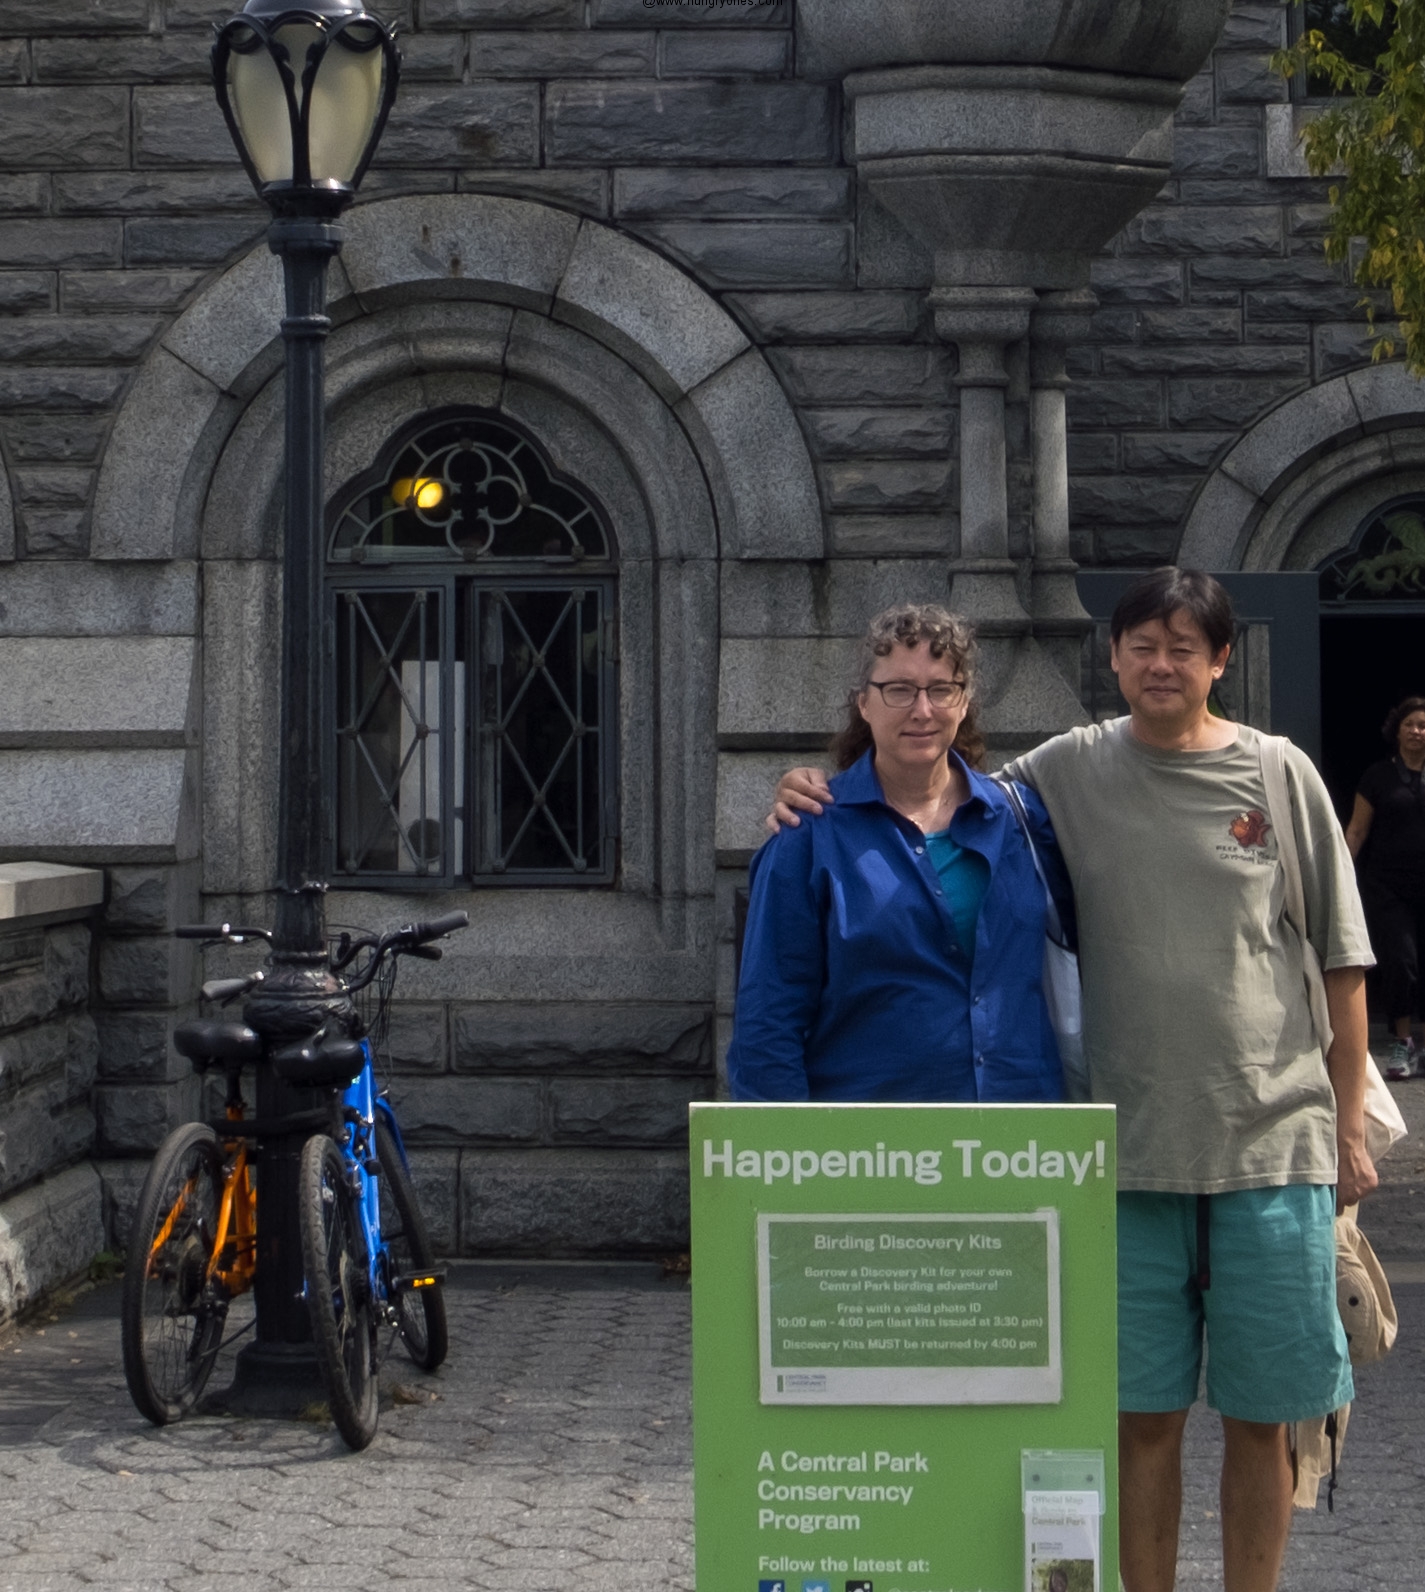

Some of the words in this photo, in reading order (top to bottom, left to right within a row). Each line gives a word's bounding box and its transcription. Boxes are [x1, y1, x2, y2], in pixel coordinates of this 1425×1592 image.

[703, 1140, 942, 1185] Happening
[953, 1140, 1106, 1185] Today!
[814, 1234, 875, 1252] Birding
[879, 1234, 963, 1251] Discovery
[969, 1234, 1002, 1250] Kits
[805, 1267, 848, 1277] Borrow
[850, 1269, 858, 1277] a
[861, 1267, 917, 1278] Discovery
[921, 1267, 936, 1277] Kit
[939, 1267, 956, 1277] for
[960, 1269, 984, 1278] your
[988, 1268, 1013, 1277] own
[819, 1281, 861, 1291] Central
[864, 1281, 890, 1291] Park
[894, 1281, 934, 1292] birding
[936, 1280, 998, 1291] adventure!
[837, 1303, 863, 1313] Free
[866, 1303, 891, 1313] with
[894, 1305, 901, 1313] a
[904, 1303, 931, 1313] valid
[933, 1302, 966, 1315] photo
[969, 1302, 981, 1313] ID
[777, 1317, 807, 1327] 10:00
[809, 1319, 827, 1327] am
[838, 1317, 864, 1327] 4:00
[866, 1319, 884, 1328] pm
[886, 1317, 912, 1327] (last
[915, 1316, 936, 1327] kits
[939, 1316, 976, 1327] issued
[979, 1317, 991, 1326] at
[993, 1316, 1019, 1327] 3:30
[1021, 1317, 1043, 1327] pm)
[783, 1339, 840, 1351] Discovery
[843, 1339, 865, 1349] Kits
[868, 1339, 901, 1349] MUST
[904, 1339, 918, 1349] be
[921, 1338, 971, 1349] returned
[974, 1338, 988, 1350] by
[991, 1338, 1017, 1348] 4:00
[1019, 1340, 1037, 1350] pm
[757, 1451, 775, 1472] A
[781, 1451, 867, 1472] Central
[874, 1451, 929, 1472] Park
[758, 1480, 914, 1505] Conservancy
[1032, 1495, 1063, 1504] Official
[1065, 1495, 1084, 1505] Map
[759, 1508, 861, 1534] Program
[1032, 1517, 1063, 1526] Central
[1066, 1517, 1086, 1526] Park
[759, 1556, 815, 1572] Follow
[820, 1557, 848, 1572] the
[853, 1557, 902, 1572] latest
[907, 1558, 930, 1572] at:
